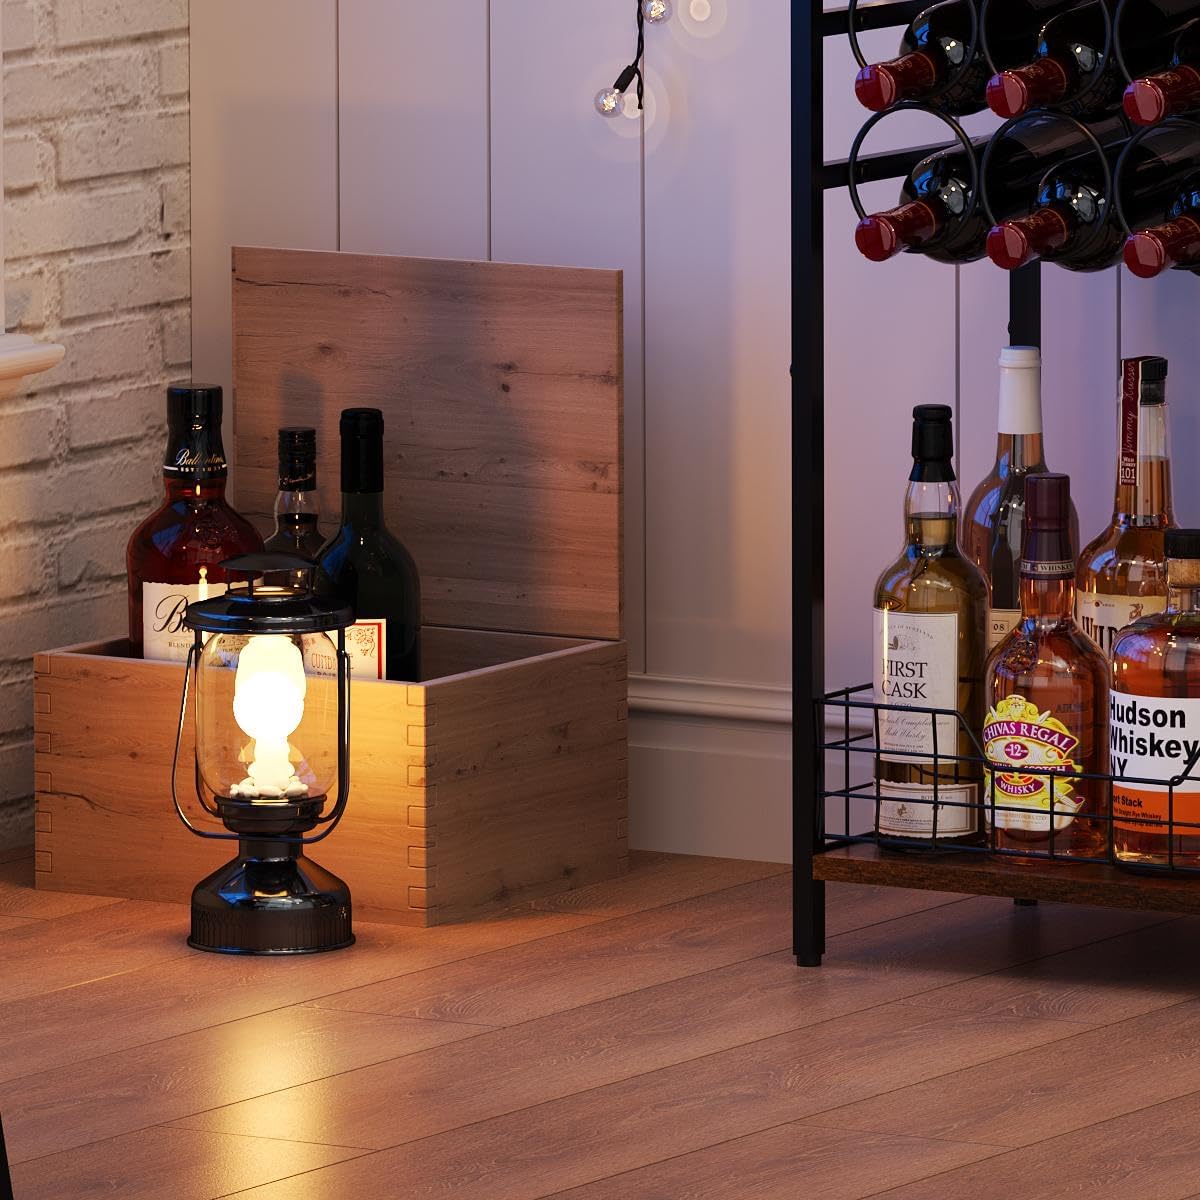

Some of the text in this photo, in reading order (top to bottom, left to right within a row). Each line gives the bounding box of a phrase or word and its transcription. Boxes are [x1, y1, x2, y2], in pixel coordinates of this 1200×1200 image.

[1121, 467, 1136, 479] 101
[882, 659, 928, 679] FIRST
[882, 680, 927, 699] CASK
[1110, 696, 1186, 728] Hudson
[985, 721, 1069, 751] CHIVAS REGAL
[1110, 725, 1200, 765] Whiskey
[1009, 743, 1021, 757] 12
[1000, 780, 1036, 794] WHISKY
[1121, 795, 1143, 808] Stack
